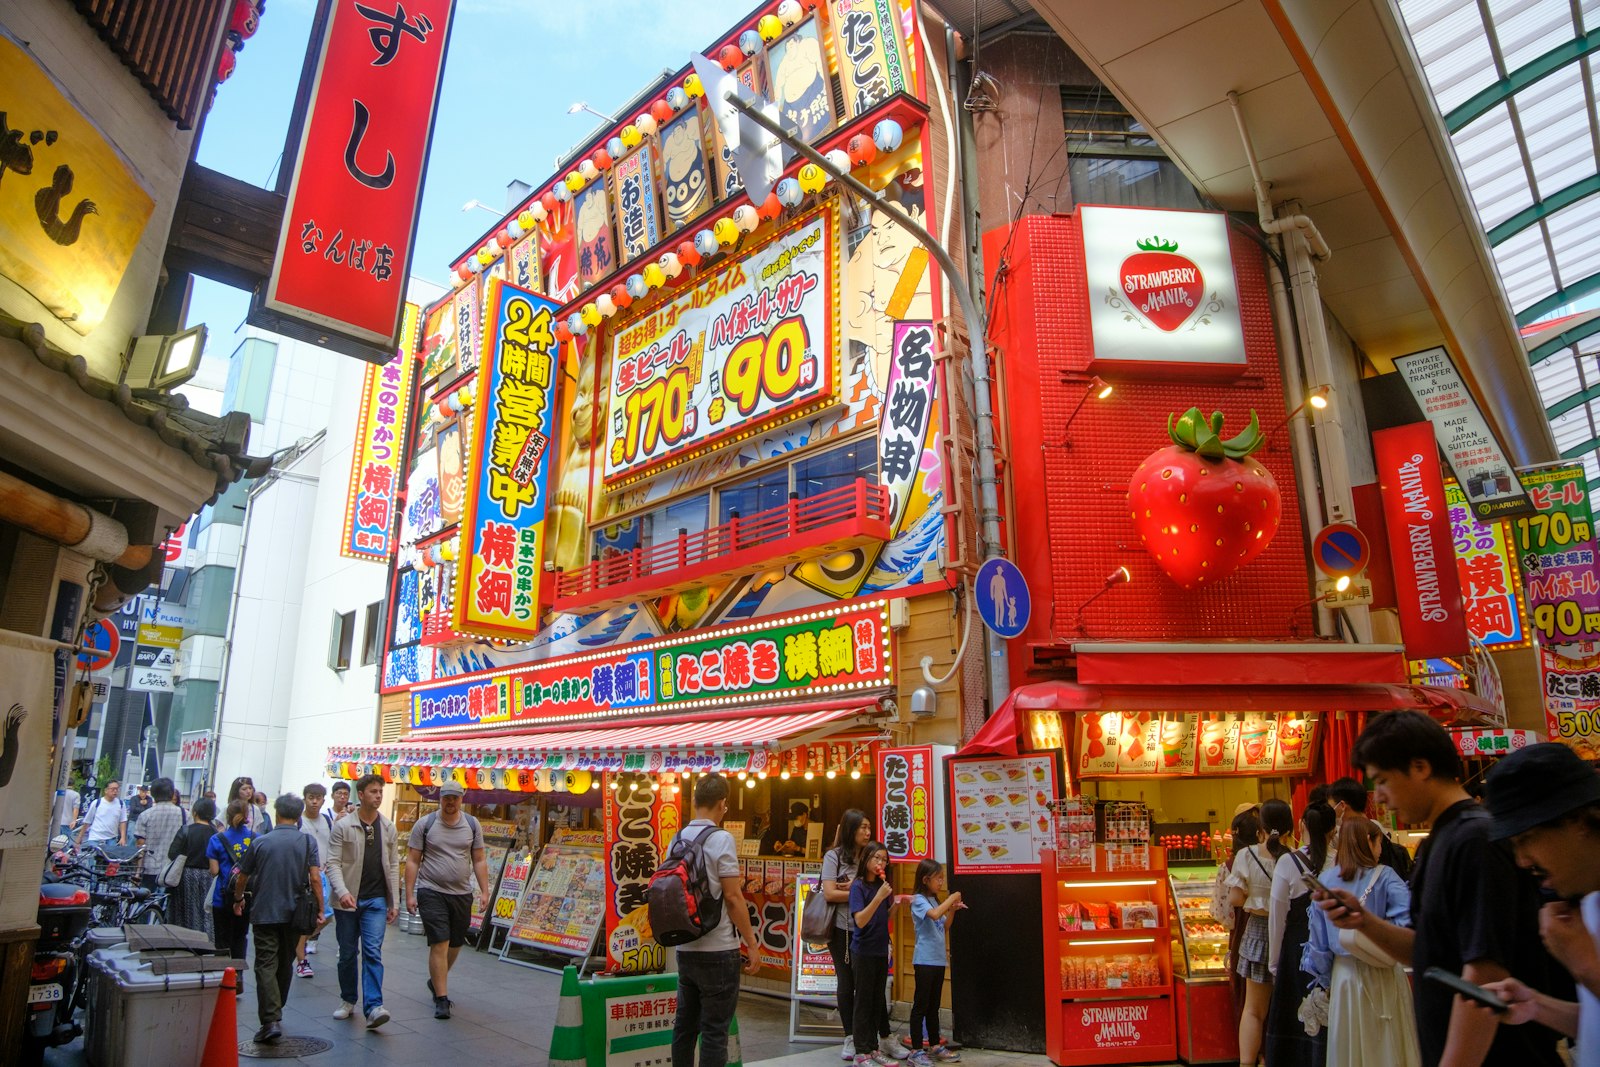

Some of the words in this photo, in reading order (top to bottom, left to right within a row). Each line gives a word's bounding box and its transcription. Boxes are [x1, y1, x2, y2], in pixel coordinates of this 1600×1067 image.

[344, 2, 434, 190] ずし
[300, 219, 395, 282] なんば店
[1124, 268, 1197, 294] STRAWBERRY
[711, 272, 816, 348] ハイボール・サワー
[1141, 286, 1194, 313] MANIA
[617, 332, 691, 394] 生ビール
[1406, 354, 1440, 368] PRIVATE
[1409, 361, 1444, 375] AIRPORT
[1409, 368, 1451, 383] TRANSFER
[1416, 386, 1435, 397] 1DAY
[1438, 381, 1459, 392] TOUR
[708, 397, 725, 425] 各
[1444, 416, 1468, 428] MADE
[879, 328, 933, 527] 名物串
[1451, 431, 1478, 442] JAPAN
[1455, 425, 1464, 433] IN
[611, 437, 625, 466] 各
[1447, 437, 1489, 451] SUITCASE
[358, 462, 394, 530] 横綱
[1398, 453, 1433, 521] MANIA
[1528, 480, 1584, 510] ビール
[1491, 499, 1526, 511] MARUWA
[355, 531, 384, 550] 名門
[1518, 511, 1591, 550] 170円
[477, 522, 516, 617] 横綱
[514, 529, 536, 619] 日本一の串かつ
[1408, 523, 1448, 623] STRAWBERRY
[1530, 570, 1599, 600] ハイボール
[678, 641, 779, 693] たこ焼き
[784, 625, 854, 681] 横綱
[524, 679, 591, 708] 日本一の串かつ
[592, 662, 637, 705] 横綱
[639, 660, 650, 700] 名門
[421, 695, 467, 720] 日本一の串かつ
[468, 684, 498, 719] 横綱
[1477, 736, 1509, 750] 横綱
[885, 756, 909, 854] たこ焼き
[615, 773, 656, 914] たこ焼き
[622, 946, 666, 972] 500
[32, 989, 60, 1000] 1738
[1081, 1005, 1149, 1026] STRAWBERRY
[1094, 1022, 1140, 1042] MANIA
